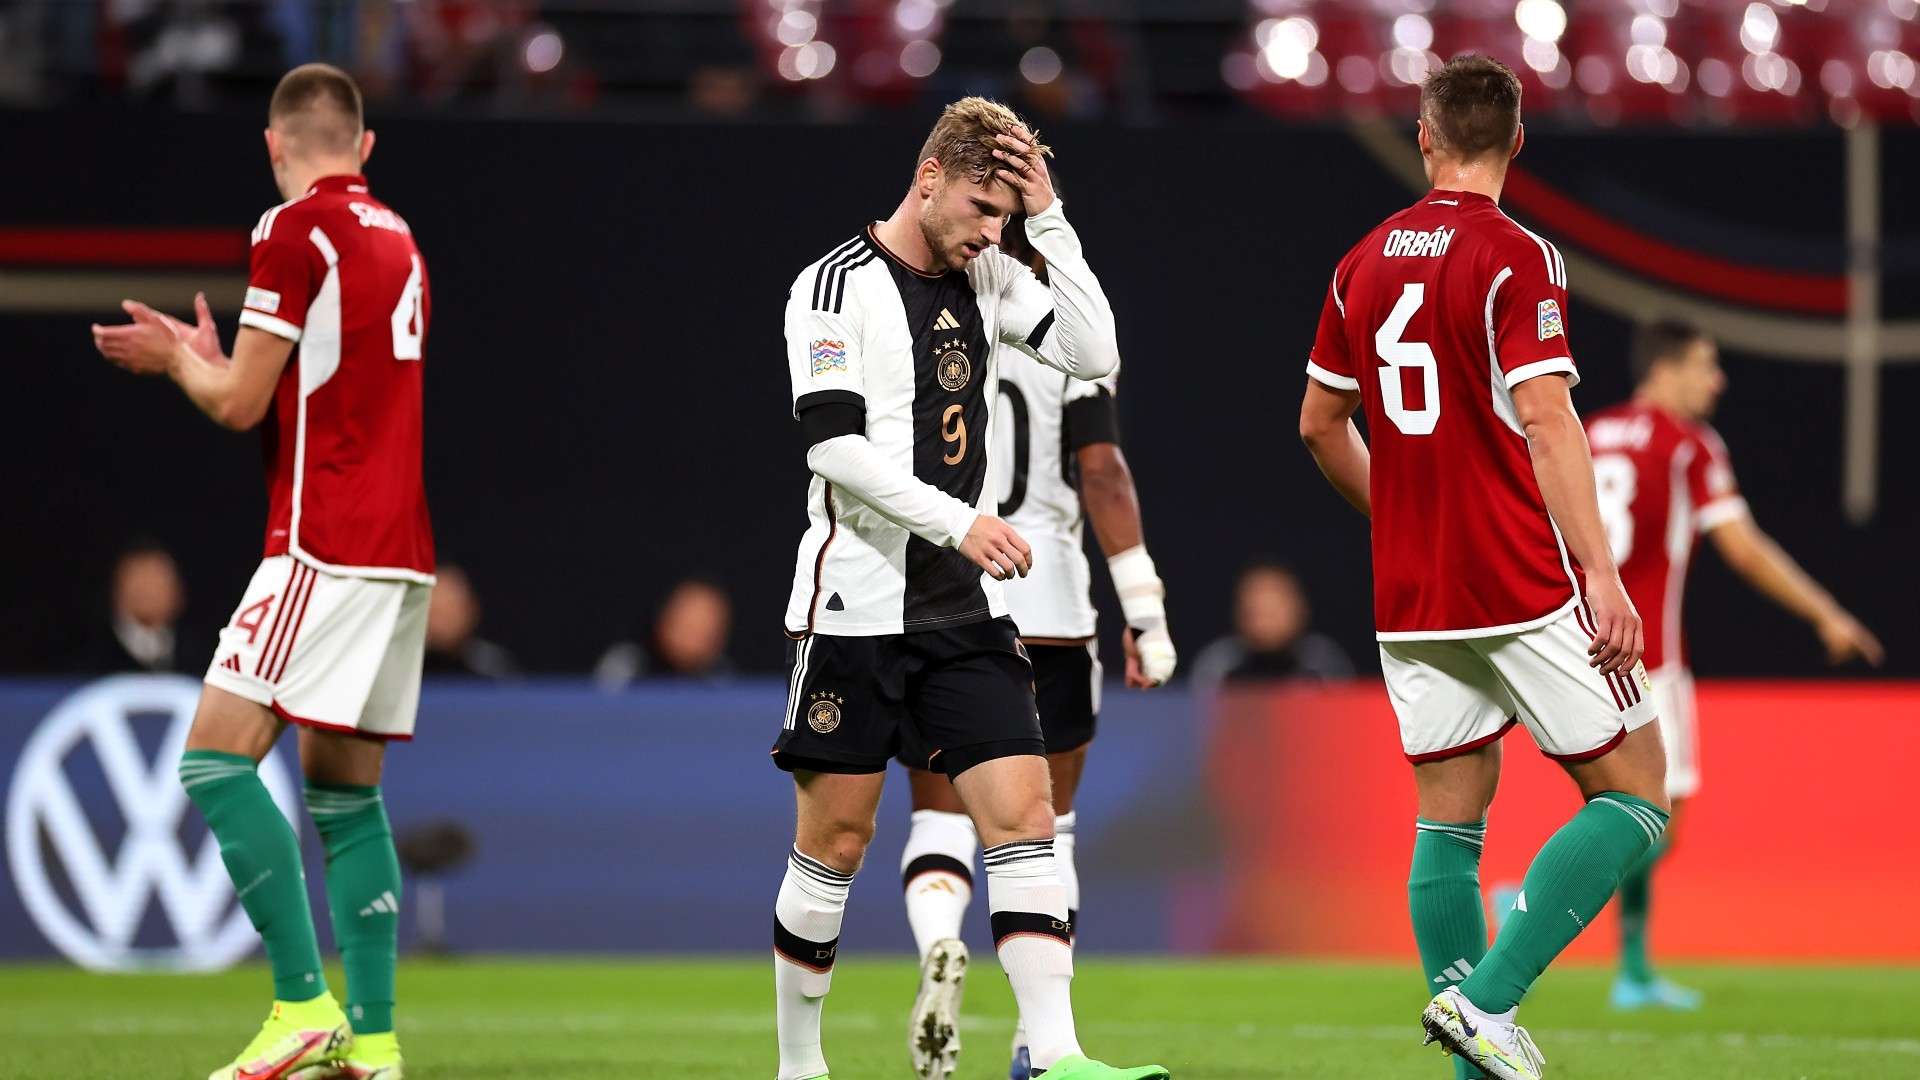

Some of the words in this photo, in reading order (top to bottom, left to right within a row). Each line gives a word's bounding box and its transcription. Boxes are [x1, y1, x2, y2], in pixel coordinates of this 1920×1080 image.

[1383, 225, 1456, 257] ORBÁN
[390, 253, 424, 361] 4
[1375, 282, 1441, 435] 6
[941, 404, 967, 466] 9
[236, 594, 275, 645] 4
[1051, 920, 1071, 933] DF
